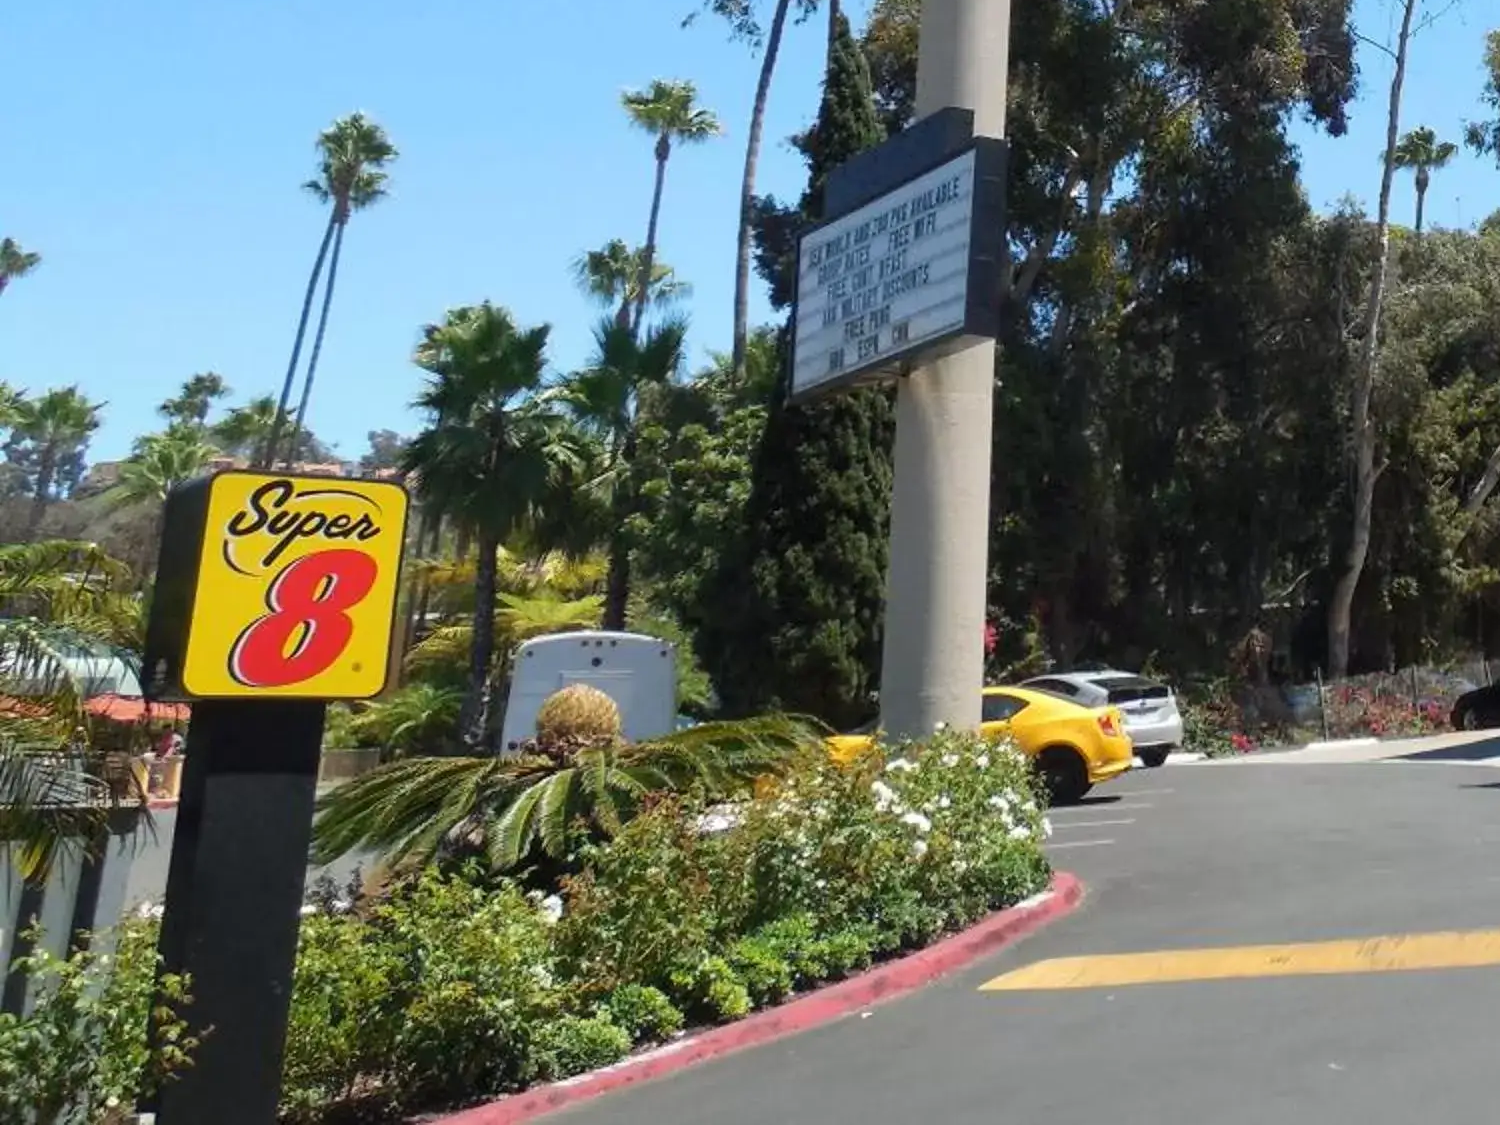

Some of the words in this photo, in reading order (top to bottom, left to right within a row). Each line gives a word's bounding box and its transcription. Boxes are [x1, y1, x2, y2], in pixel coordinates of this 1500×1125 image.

[910, 176, 960, 218] AVAILABLE
[888, 223, 911, 251] FREE
[826, 276, 847, 303] FREE
[841, 286, 877, 318] MILITARY
[843, 315, 864, 341] FREE
[857, 333, 879, 360] ESPN
[228, 479, 381, 568] Super
[227, 548, 378, 687] 8
